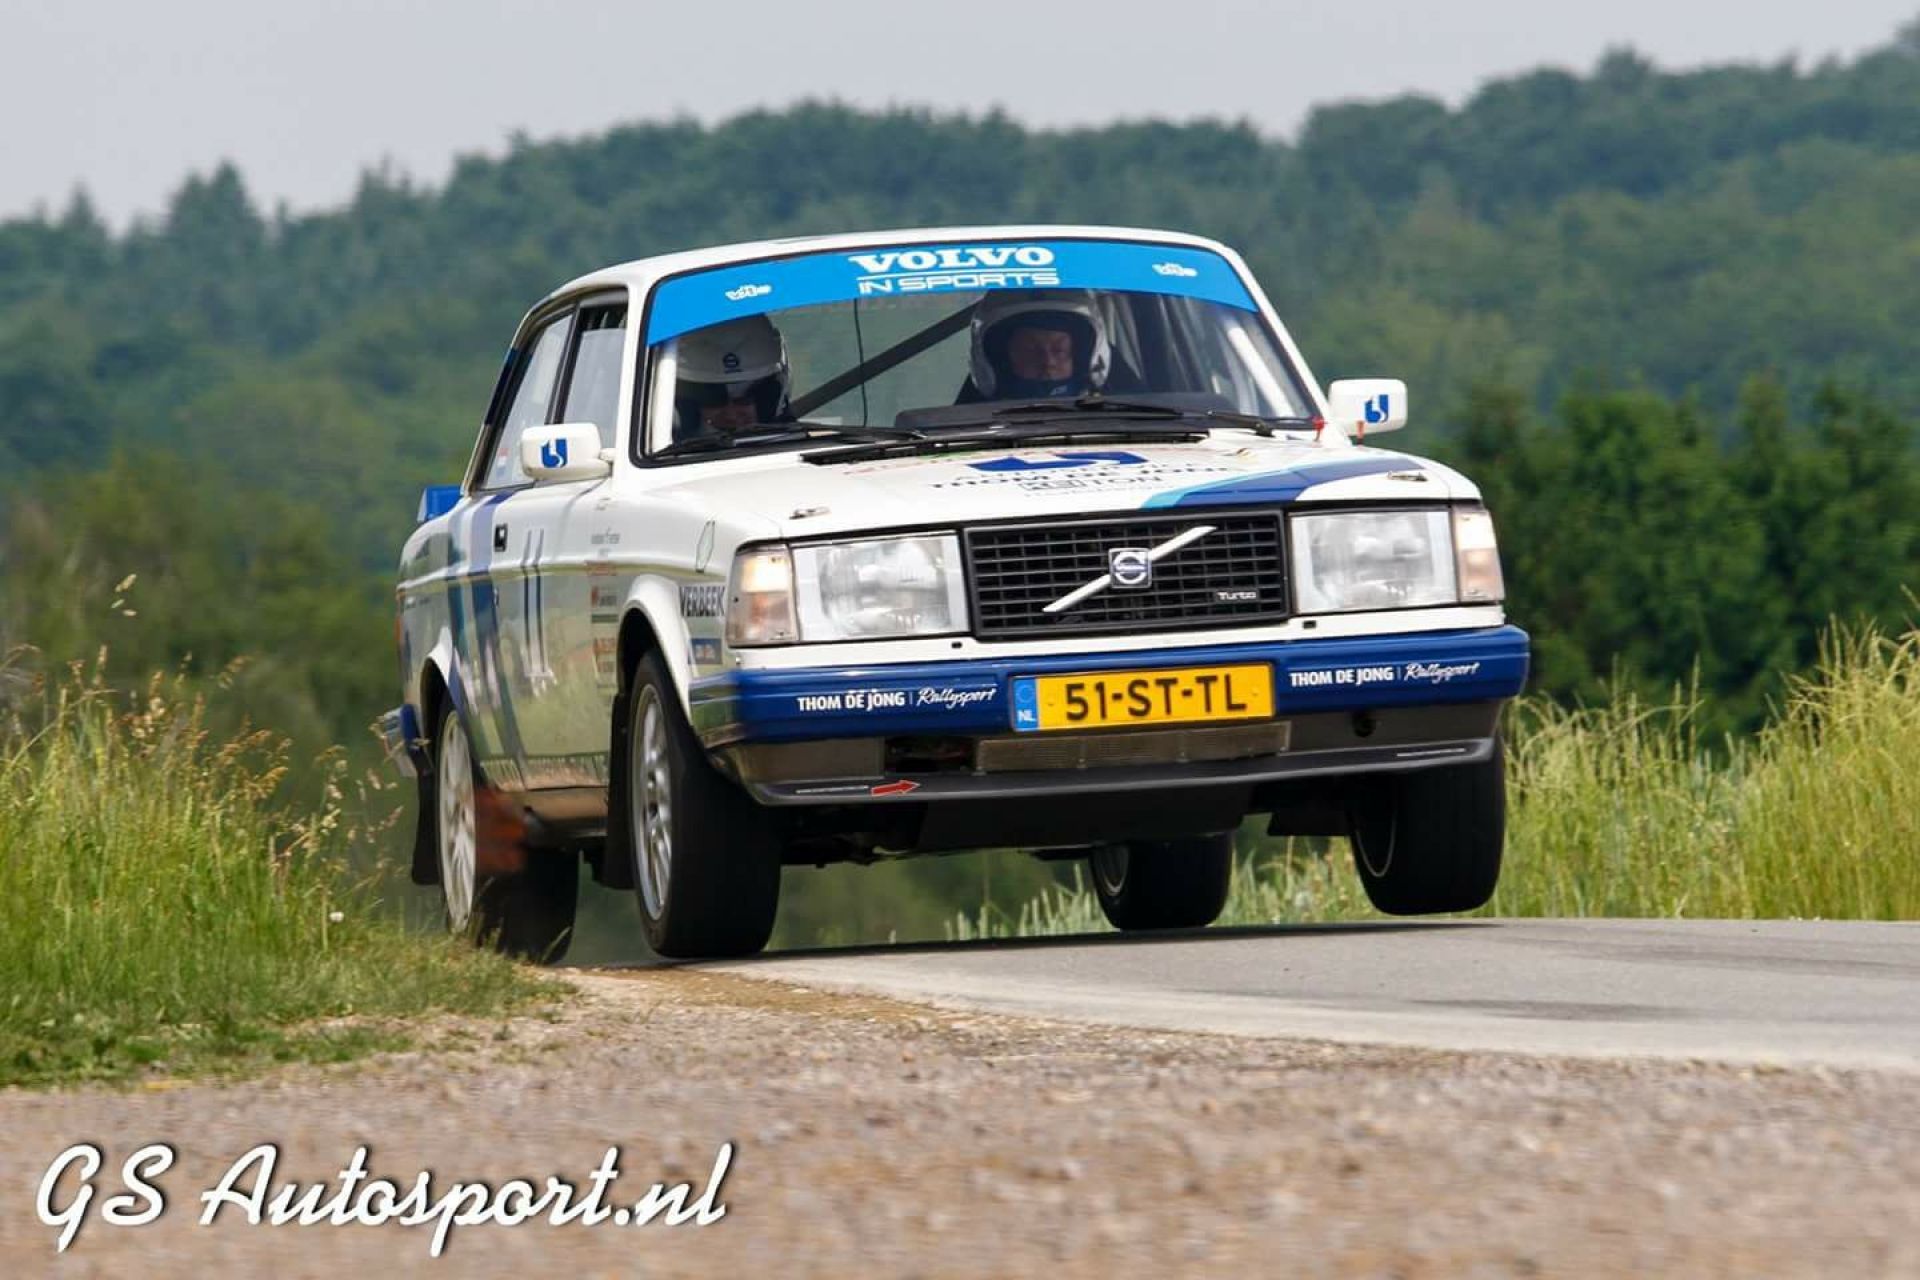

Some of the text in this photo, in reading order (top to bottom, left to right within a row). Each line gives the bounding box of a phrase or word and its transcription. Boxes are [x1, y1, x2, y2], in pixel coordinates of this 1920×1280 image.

[849, 247, 1055, 273] VOLVO
[859, 272, 1060, 295] IN SPORTS
[679, 585, 726, 617] VERBEEK
[1217, 591, 1257, 600] Turbo
[1289, 662, 1481, 687] THOM DE JONG Rallysport
[797, 687, 997, 712] THOM DE JONG Rallysport
[1016, 673, 1248, 722] NL 51-ST-TL
